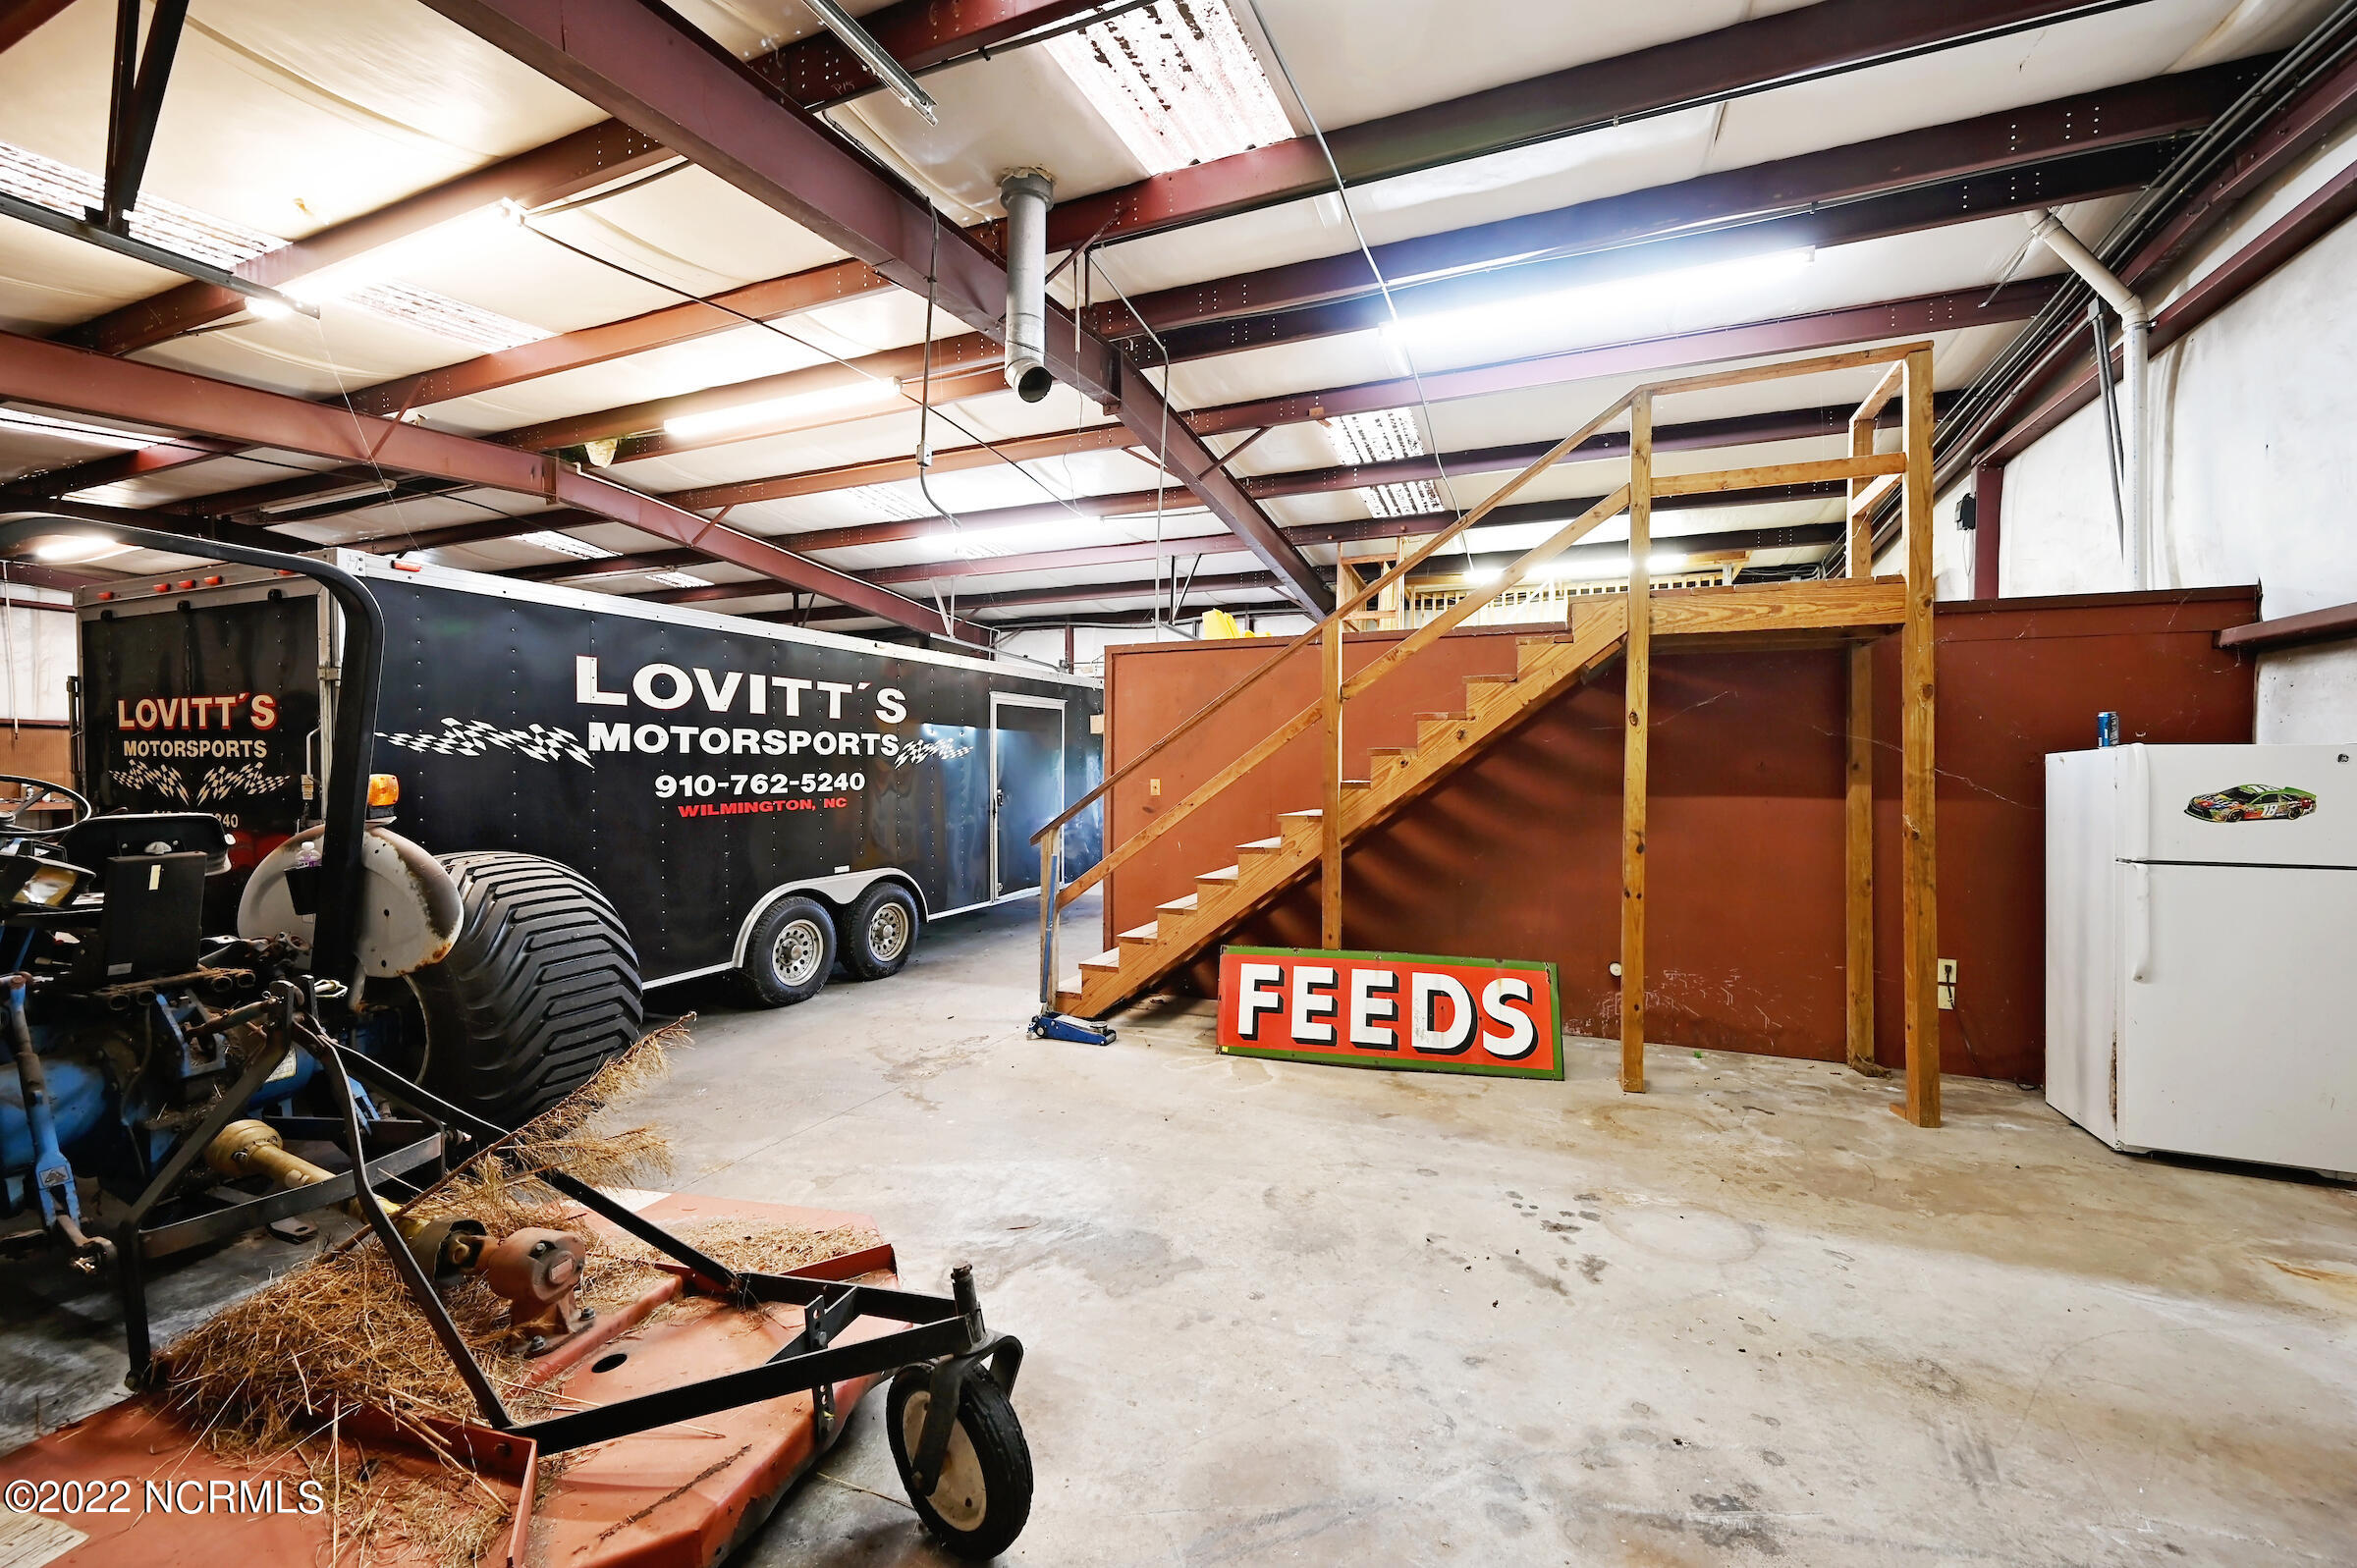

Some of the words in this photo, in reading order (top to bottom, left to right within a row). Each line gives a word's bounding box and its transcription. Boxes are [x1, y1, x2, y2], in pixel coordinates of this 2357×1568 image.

[123, 739, 268, 759] MOTORSPORTS
[588, 722, 900, 757] MOTORSPORTS
[654, 772, 866, 798] 910-762-5240
[678, 798, 816, 818] WILMINGTON,
[823, 797, 848, 809] NC
[2261, 804, 2278, 817] 18
[1237, 963, 1539, 1060] FEEDS
